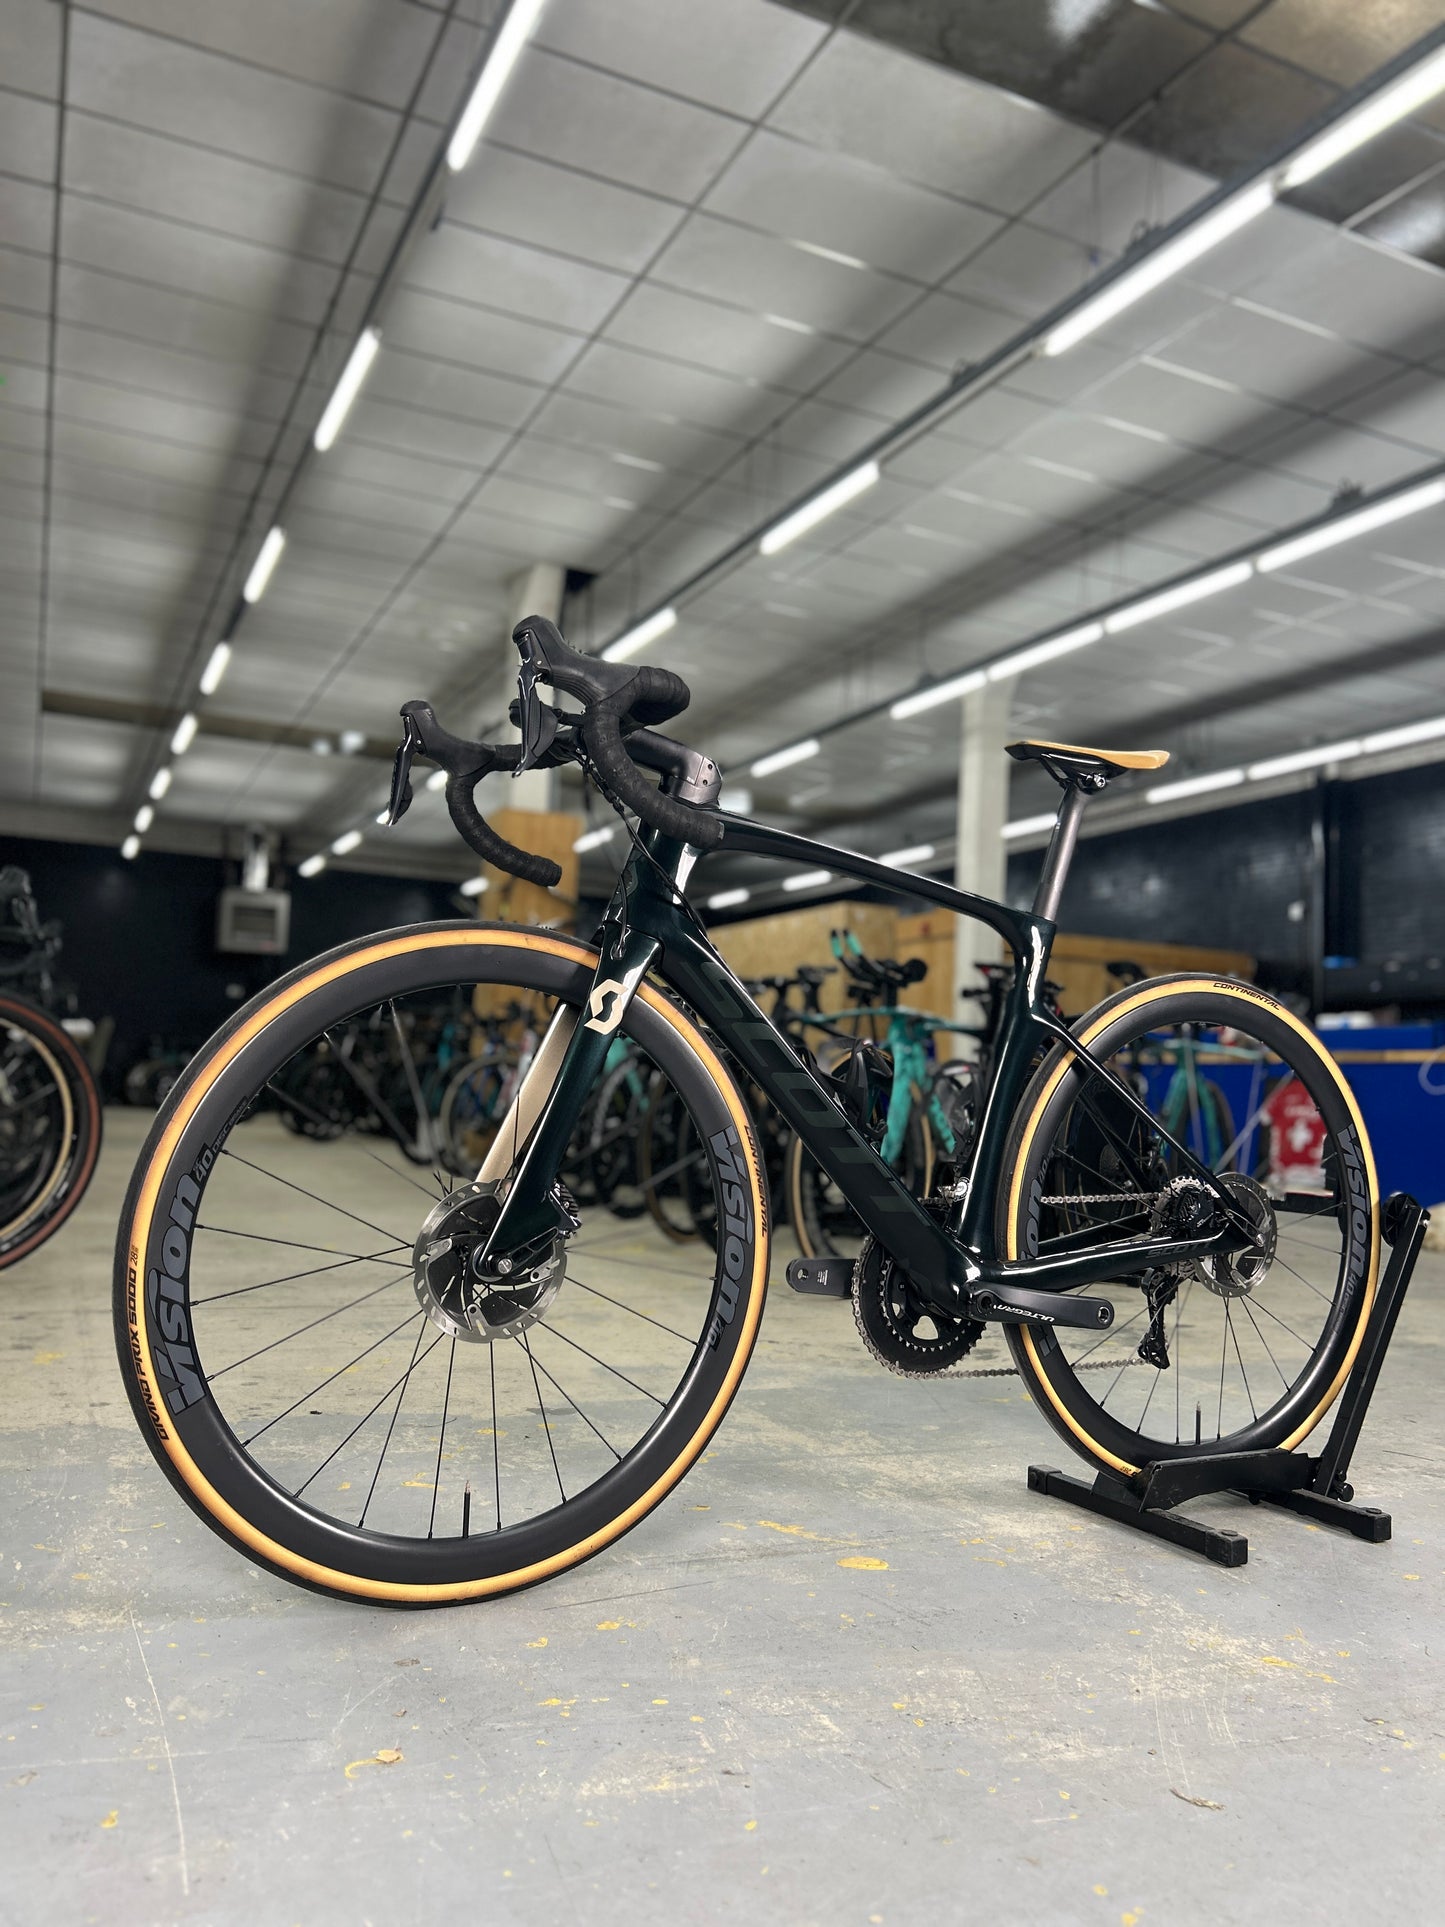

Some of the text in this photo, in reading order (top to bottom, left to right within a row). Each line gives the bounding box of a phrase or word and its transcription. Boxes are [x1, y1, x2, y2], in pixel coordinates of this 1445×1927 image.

[1213, 982, 1280, 1011] CONTINENTAL
[195, 1148, 214, 1182] 40
[744, 1124, 769, 1238] CONTINENTAL
[1146, 1242, 1212, 1259] SCOTT
[128, 1267, 137, 1327] 5000
[993, 1303, 1055, 1322] ULTEGRA
[130, 1327, 147, 1377] PRIX
[139, 1379, 170, 1441] GRAND
